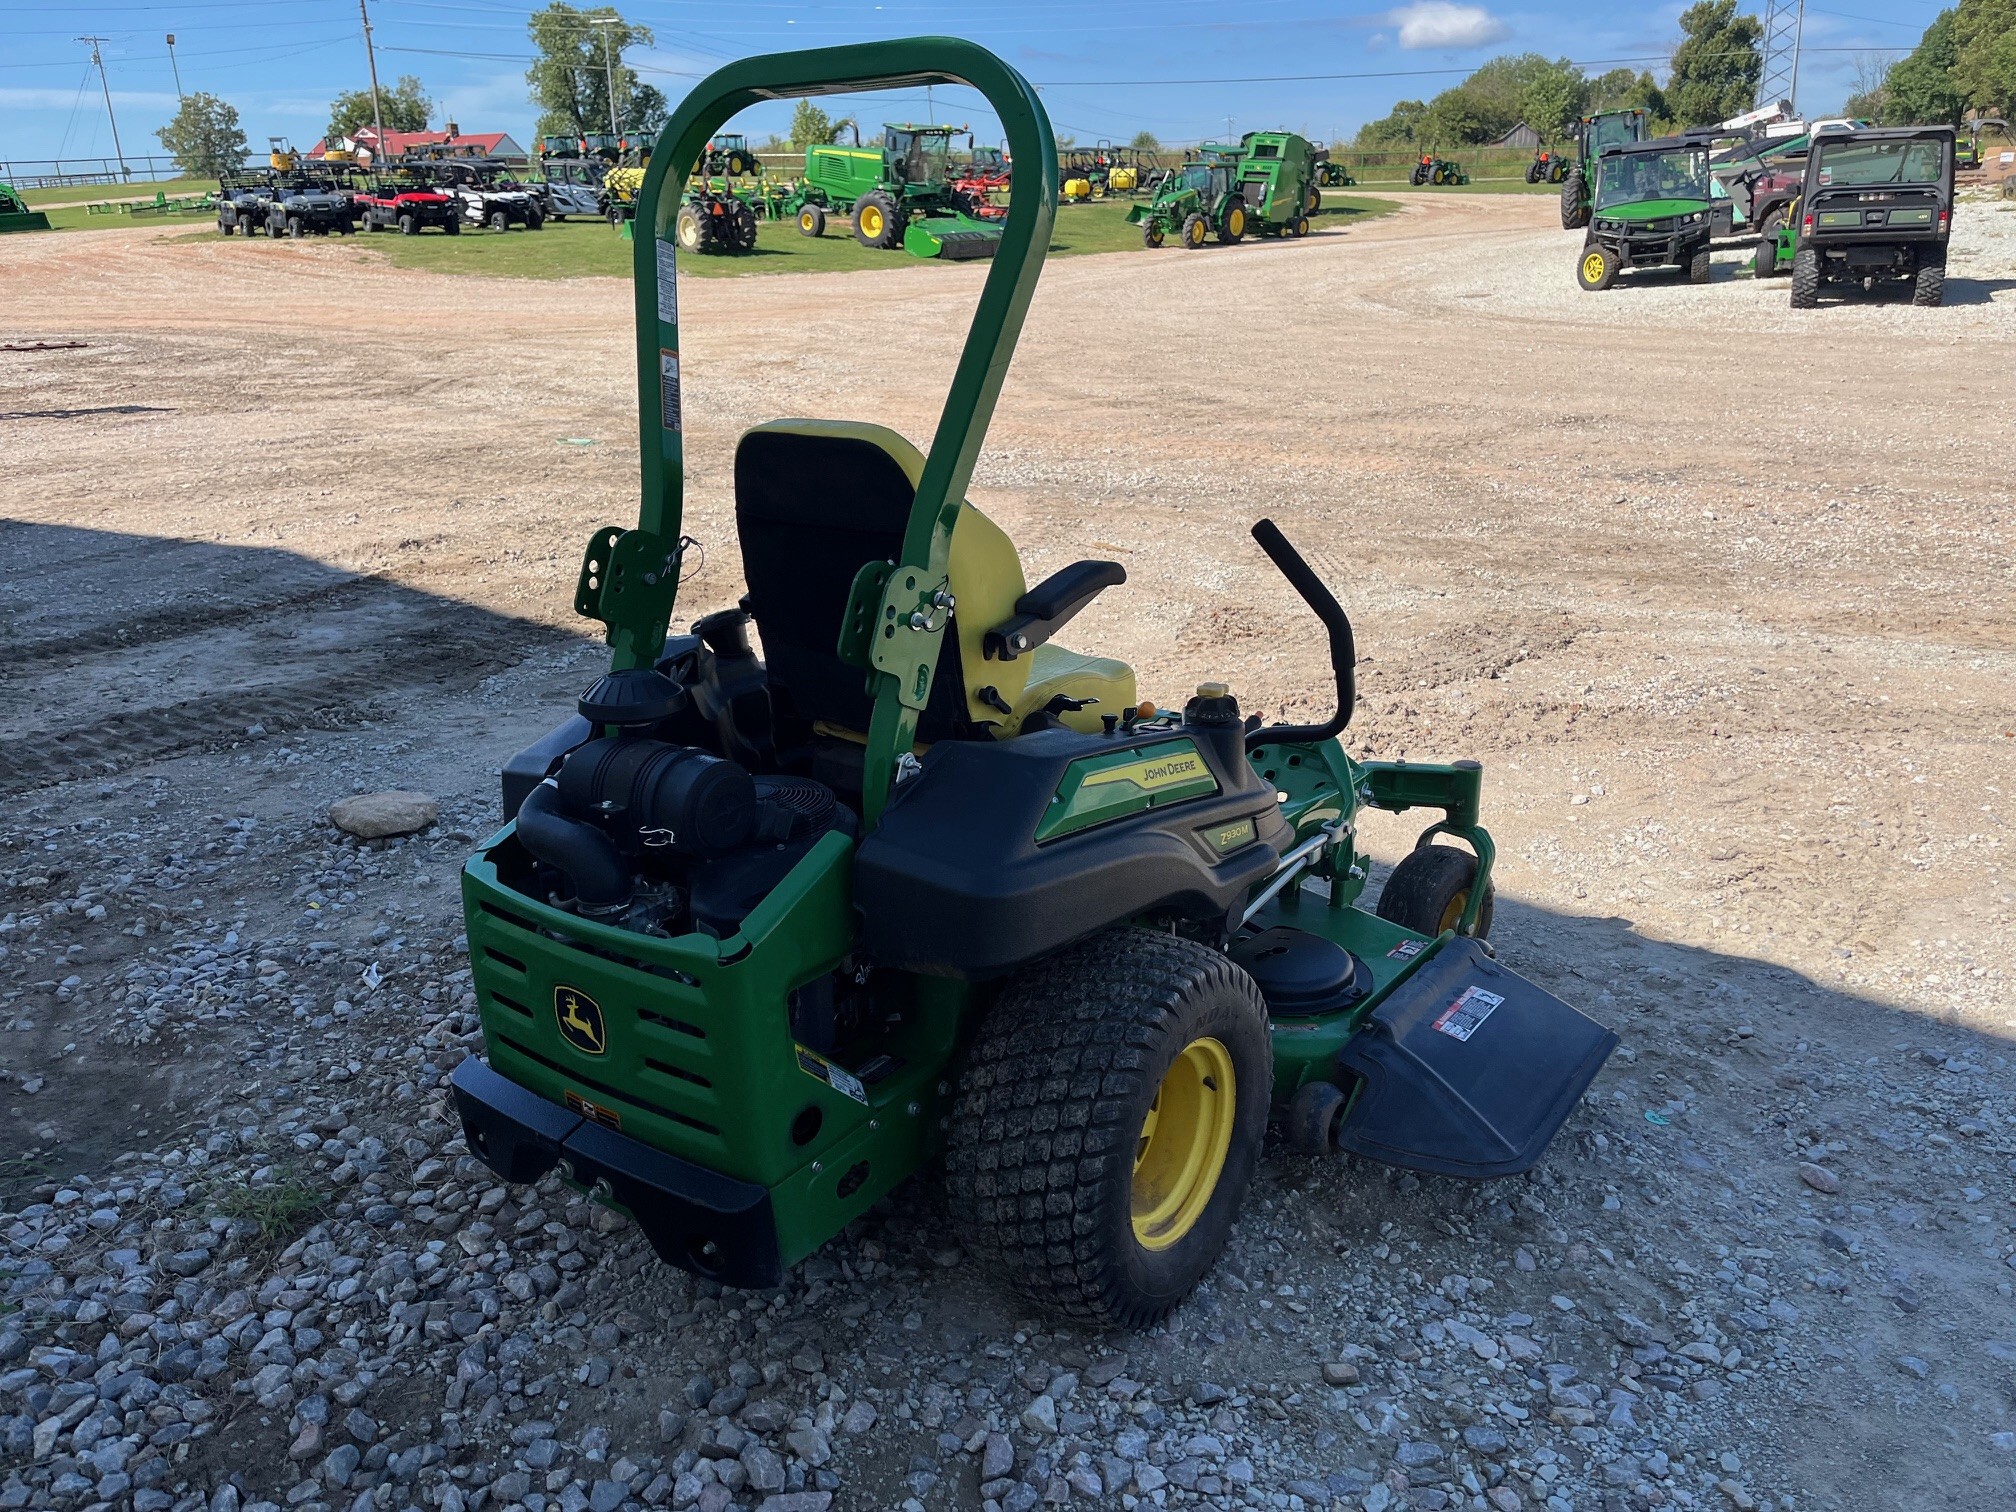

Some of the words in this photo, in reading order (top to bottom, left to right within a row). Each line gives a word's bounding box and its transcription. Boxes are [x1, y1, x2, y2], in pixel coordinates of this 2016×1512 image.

[1144, 767, 1167, 781] JOHN
[1167, 760, 1196, 775] DEERE
[1220, 825, 1249, 846] Z930M
